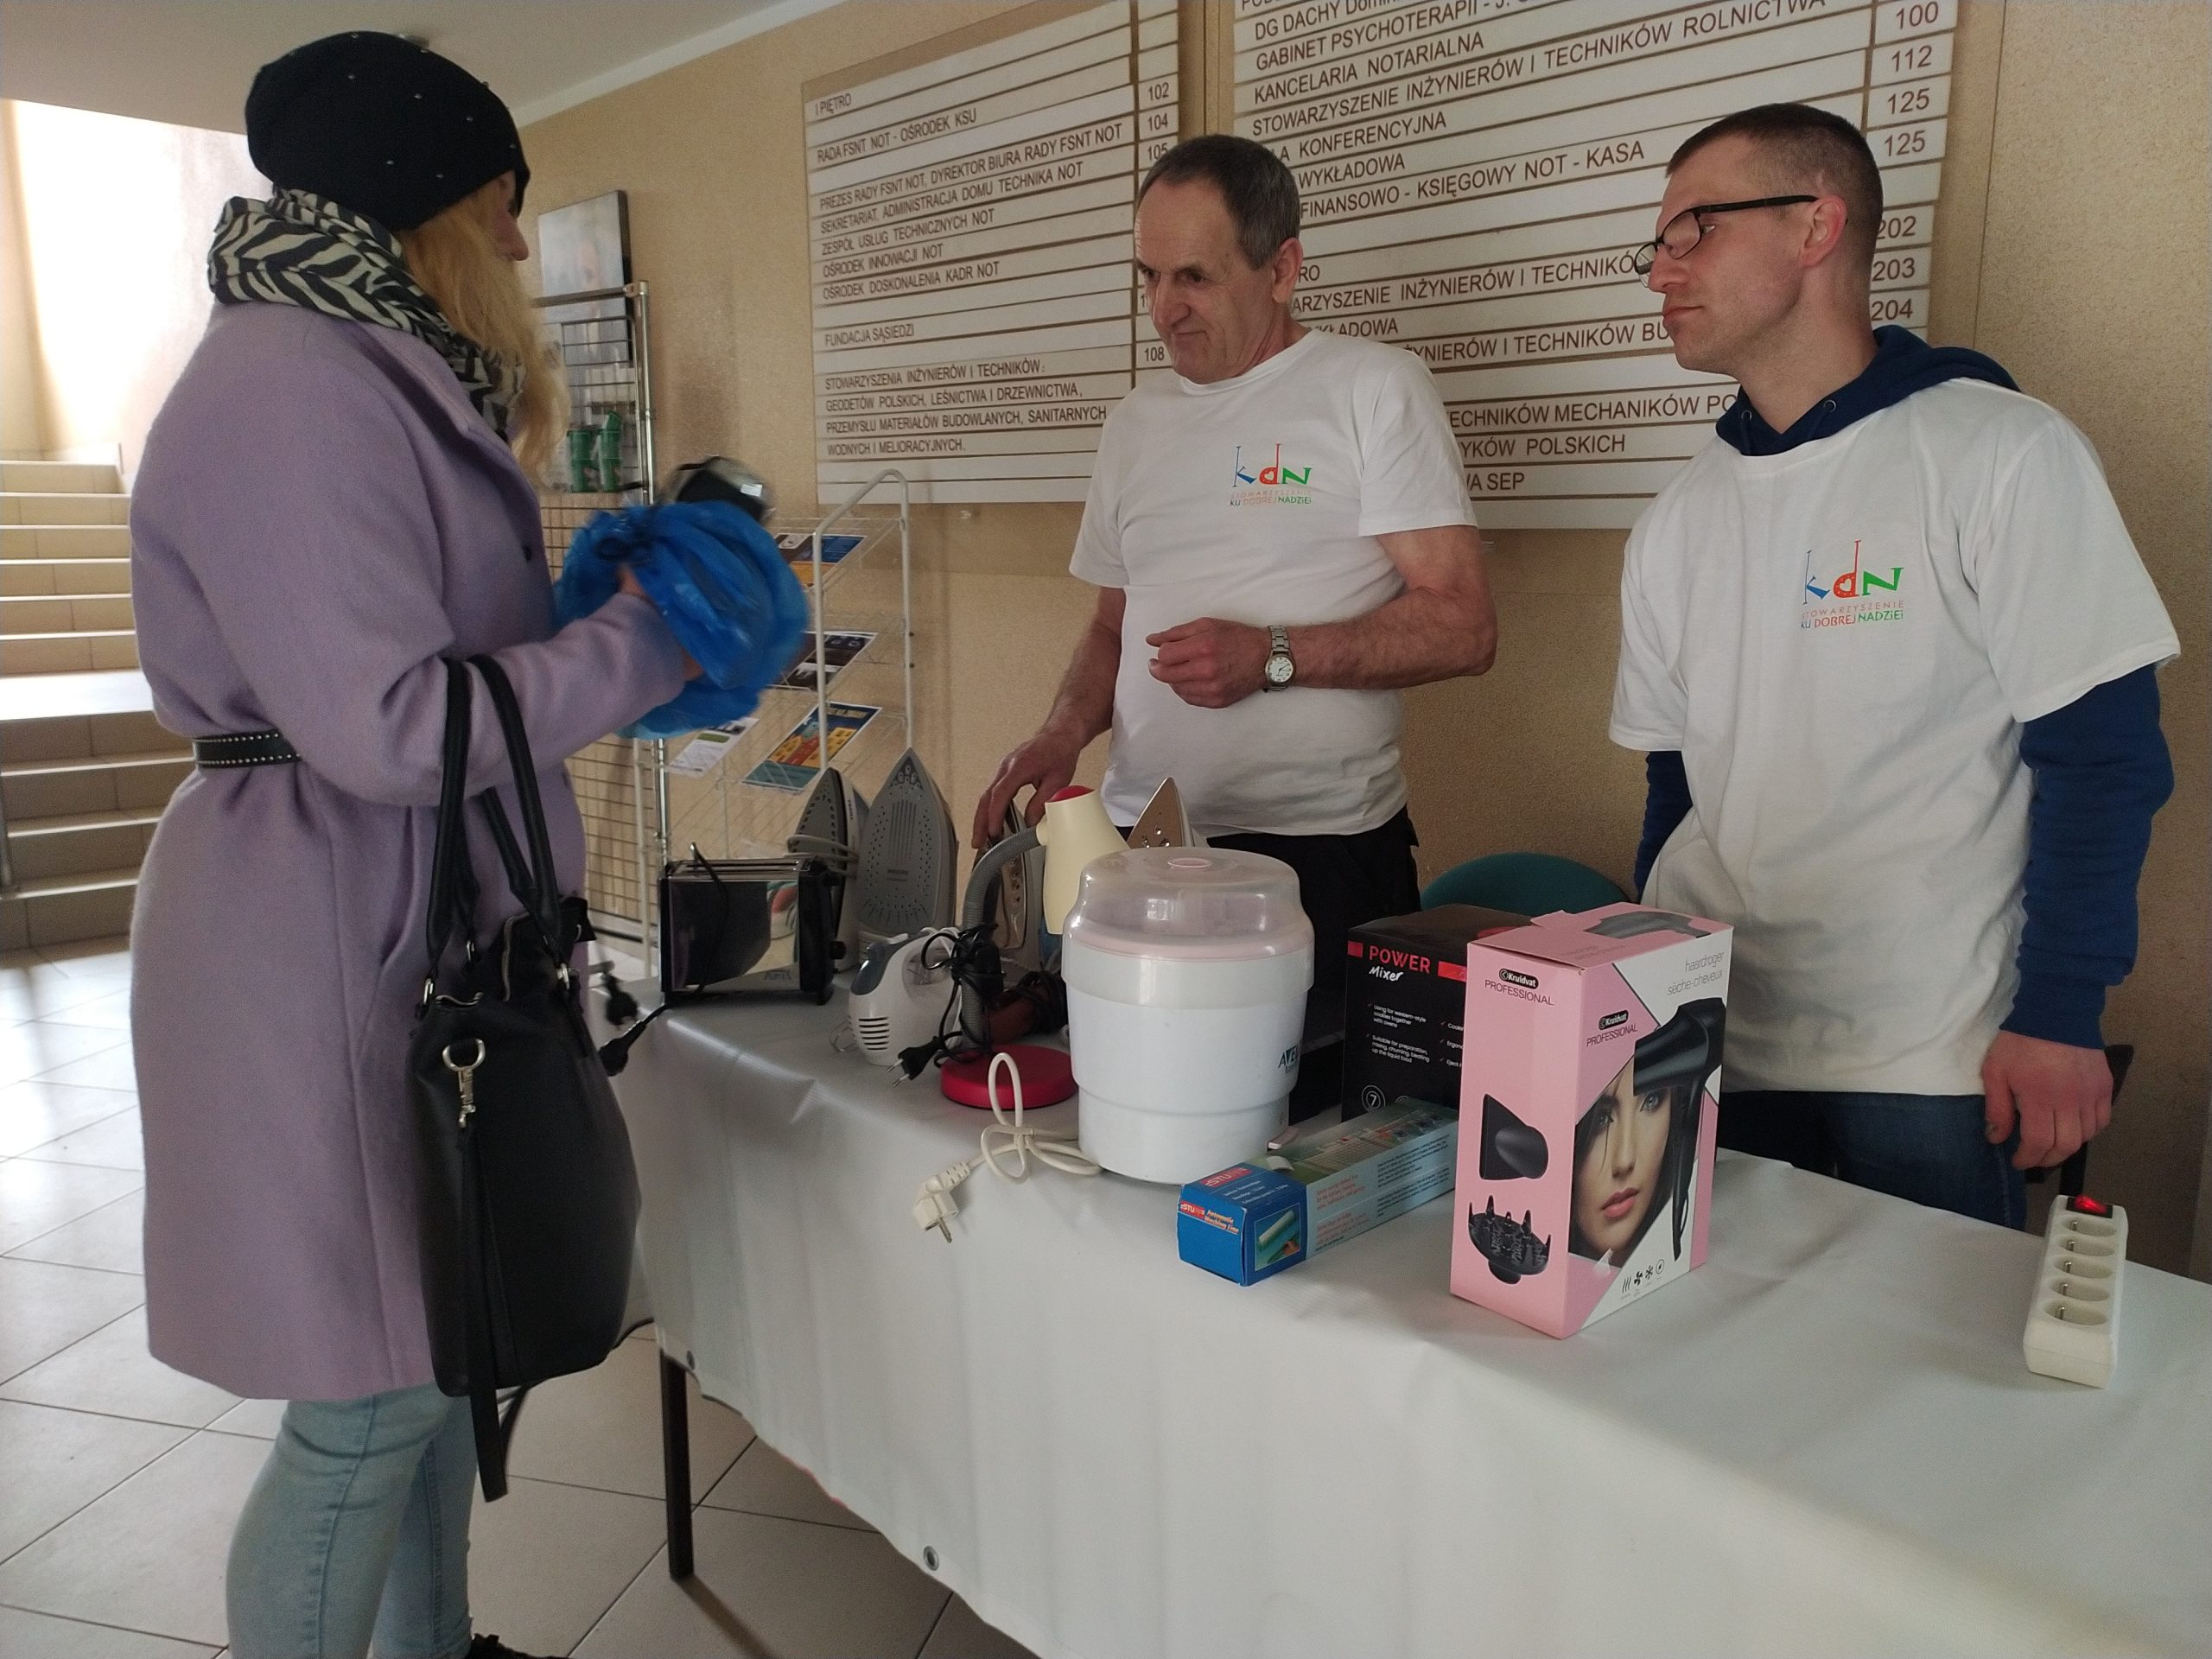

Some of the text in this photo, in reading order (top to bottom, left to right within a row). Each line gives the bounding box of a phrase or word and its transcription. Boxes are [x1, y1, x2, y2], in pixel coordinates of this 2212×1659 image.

[1255, 16, 1279, 41] DG
[1283, 0, 1340, 33] DACHY
[1896, 1, 1939, 29] 100
[1255, 37, 1327, 71] GABINET
[1331, 0, 1478, 53] PSYCHOTERAPII
[1255, 32, 1484, 104] KANCELARIA NOTARIALNA
[1891, 46, 1932, 72] 112
[1147, 82, 1170, 100] 102
[1253, 87, 1399, 136] STOWARZYSZENIE
[1407, 57, 1524, 102] INŻYNIERÓW
[1531, 55, 1535, 73] I
[1544, 22, 1674, 70] TECHNIKÓW
[820, 93, 851, 114] PIĘTRO
[1887, 88, 1930, 114] 125
[1147, 113, 1168, 131] 104
[1299, 111, 1446, 158] KONFERENCYJNA
[817, 146, 842, 163] RADA
[843, 138, 866, 156] FSNT
[871, 132, 890, 149] NOT
[900, 116, 950, 142] OŚRODEK
[955, 108, 977, 126] KSU
[1885, 130, 1925, 156] 125
[1147, 143, 1168, 162] 105
[820, 191, 853, 210] PREZES
[855, 186, 878, 202] RADY
[880, 181, 904, 196] FSNT
[931, 156, 986, 183] DYREKTOR
[988, 149, 1021, 170] BIURA
[1024, 140, 1058, 162] RADY
[1060, 131, 1091, 153] FSNT
[1095, 123, 1122, 143] NOT
[1299, 153, 1405, 190] WYKŁADOWA
[1300, 186, 1400, 219] FINANSOWO
[1417, 163, 1516, 199] KSIĘGOWY
[1524, 154, 1567, 181] NOT
[1586, 140, 1644, 168] KASA
[882, 190, 958, 218] ADMINISTRACJA
[962, 181, 993, 200] DOMU
[999, 169, 1054, 194] TECHNIKA
[1058, 162, 1084, 181] NOT
[859, 231, 888, 248] USŁUG
[893, 217, 968, 241] TECHNICZNYCH
[972, 208, 995, 225] NOT
[1876, 216, 1916, 239] 202
[823, 243, 944, 277] OŚRODEK INNOWACJI NOT
[1872, 257, 1915, 282] 203
[823, 261, 1001, 300] OŚRODEK DOSKONALENIA KADR NOT
[1293, 287, 1389, 313] ARZYSZENIE
[1401, 268, 1515, 302] INŻYNIERÓW
[1532, 249, 1635, 285] TECHNIKÓ
[1871, 299, 1912, 321] 204
[825, 323, 914, 346] FUNDACJA SĄSIEDZI
[1403, 338, 1497, 361] YNIERÓW
[1515, 322, 1635, 355] TECHNIKÓW
[1144, 346, 1165, 362] 108
[825, 372, 902, 390] STOWARZYSZENIA
[907, 363, 966, 383] INŻYNIERÓW
[826, 396, 874, 411] GEODETÓW
[931, 387, 987, 405] LEŚNICTWA
[997, 382, 1083, 402] DRZEWNICTWA,
[827, 420, 876, 434] PRZEMYSŁU
[880, 414, 938, 430] MATERIAŁÓW
[1028, 405, 1106, 423] SANITARNYCH
[1446, 403, 1550, 427] ECHNIKÓW
[1555, 394, 1700, 423] MECHANIKÓW
[828, 442, 870, 455] WODNYCH
[1527, 435, 1625, 455] POLSKICH
[1487, 473, 1524, 490] SEP
[1801, 620, 1810, 629] KU
[1815, 615, 1855, 627] DOBREJ
[1802, 601, 1904, 620] STOWARZYSZENIE
[1370, 945, 1431, 974] POWER
[1685, 951, 1725, 973] haardroger
[1369, 966, 1403, 982] Mixer
[1507, 971, 1536, 988] Kruidvat
[1484, 980, 1554, 1006] PROFESSIONAL
[1605, 1013, 1627, 1027] Kruidvat
[1586, 1023, 1637, 1047] PROFESSIONAL
[1370, 1094, 1377, 1106] 7
